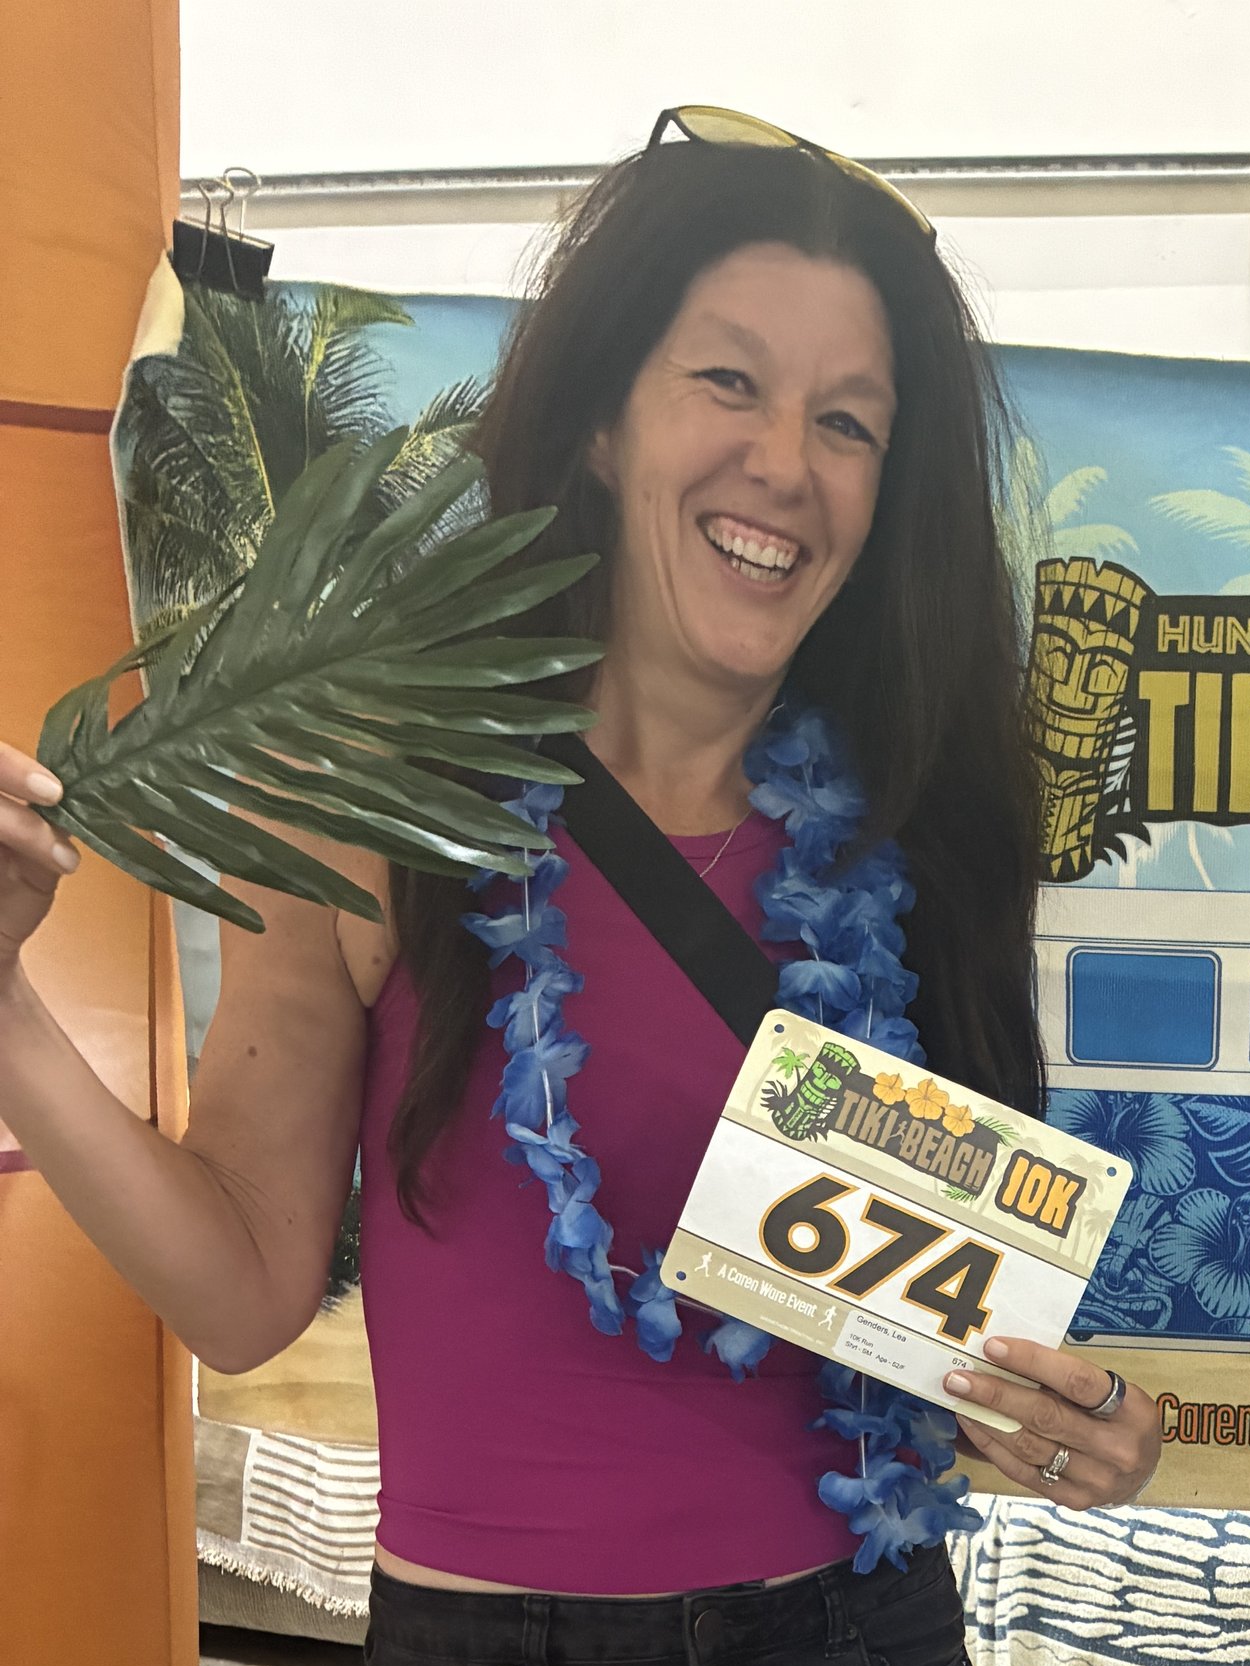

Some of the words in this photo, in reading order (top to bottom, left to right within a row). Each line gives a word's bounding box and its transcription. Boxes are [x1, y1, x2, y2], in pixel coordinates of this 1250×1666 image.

[834, 1089, 900, 1148] TIKI
[899, 1119, 995, 1192] BEACH
[1000, 1155, 1081, 1231] 10K
[717, 1264, 727, 1278] A
[727, 1267, 760, 1292] Caren
[760, 1280, 787, 1303] Ware
[786, 1293, 818, 1318] Event
[759, 1172, 1005, 1346] 674
[856, 1315, 890, 1336] Genders,
[892, 1331, 907, 1342] Lea
[951, 1357, 967, 1368] 674
